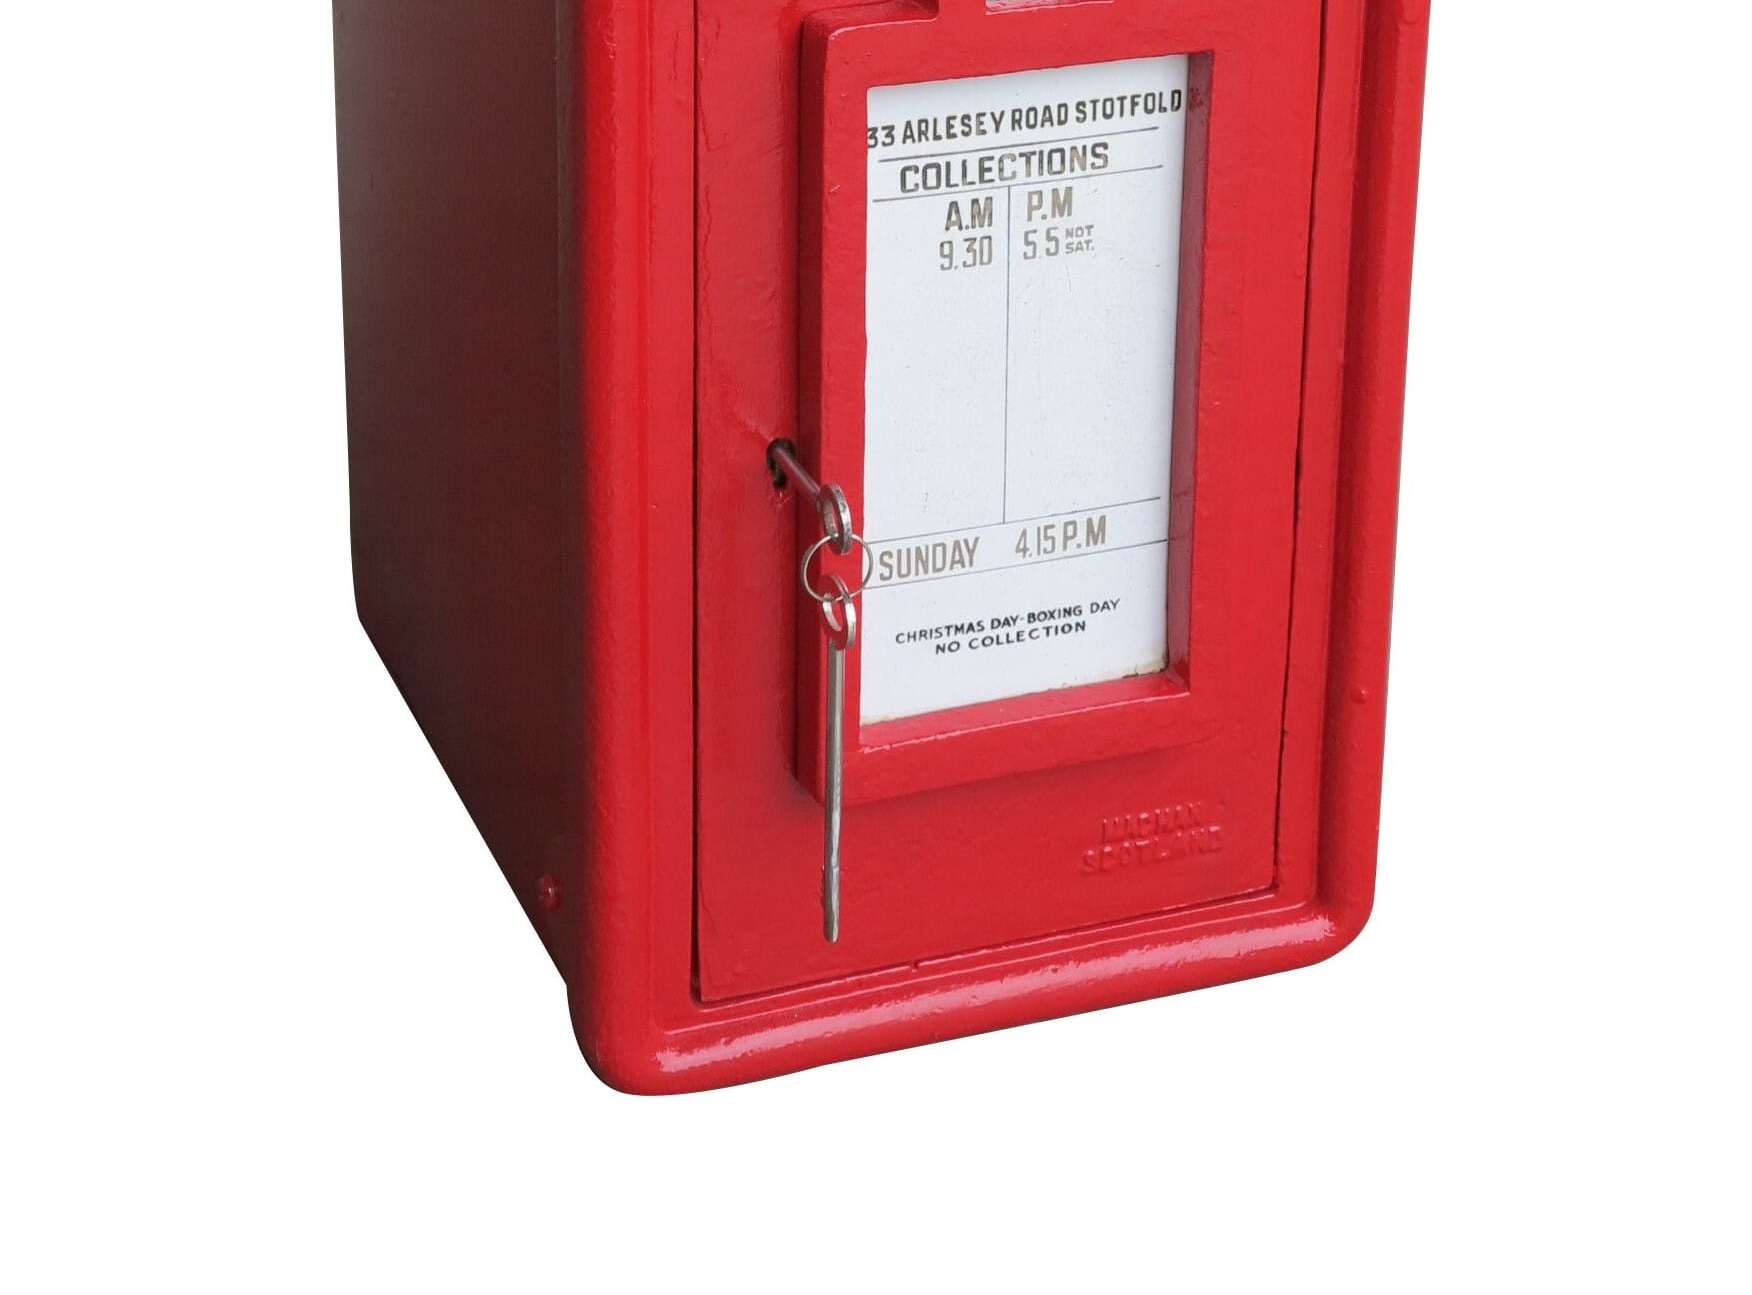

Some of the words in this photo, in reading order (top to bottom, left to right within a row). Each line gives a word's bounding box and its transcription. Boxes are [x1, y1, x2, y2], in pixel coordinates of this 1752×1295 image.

[901, 110, 1006, 145] ARLESEY
[1010, 102, 1070, 132] ROAD
[1075, 88, 1183, 124] STOTFOLD
[899, 141, 1110, 195] COLLECTIONS
[944, 195, 994, 232] A.M
[1026, 185, 1074, 222] P.M
[1064, 223, 1095, 240] NOT
[939, 235, 994, 271] 9.30
[1064, 238, 1095, 255] SAT.
[878, 535, 981, 582] SUNDAY
[1062, 514, 1108, 552] P.M
[894, 619, 986, 645] CHRISTMAS
[1089, 597, 1122, 615] DAY
[934, 640, 962, 655] NO
[967, 619, 1088, 651] COLLECTION
[1082, 825, 1221, 876] SCOTLAND
